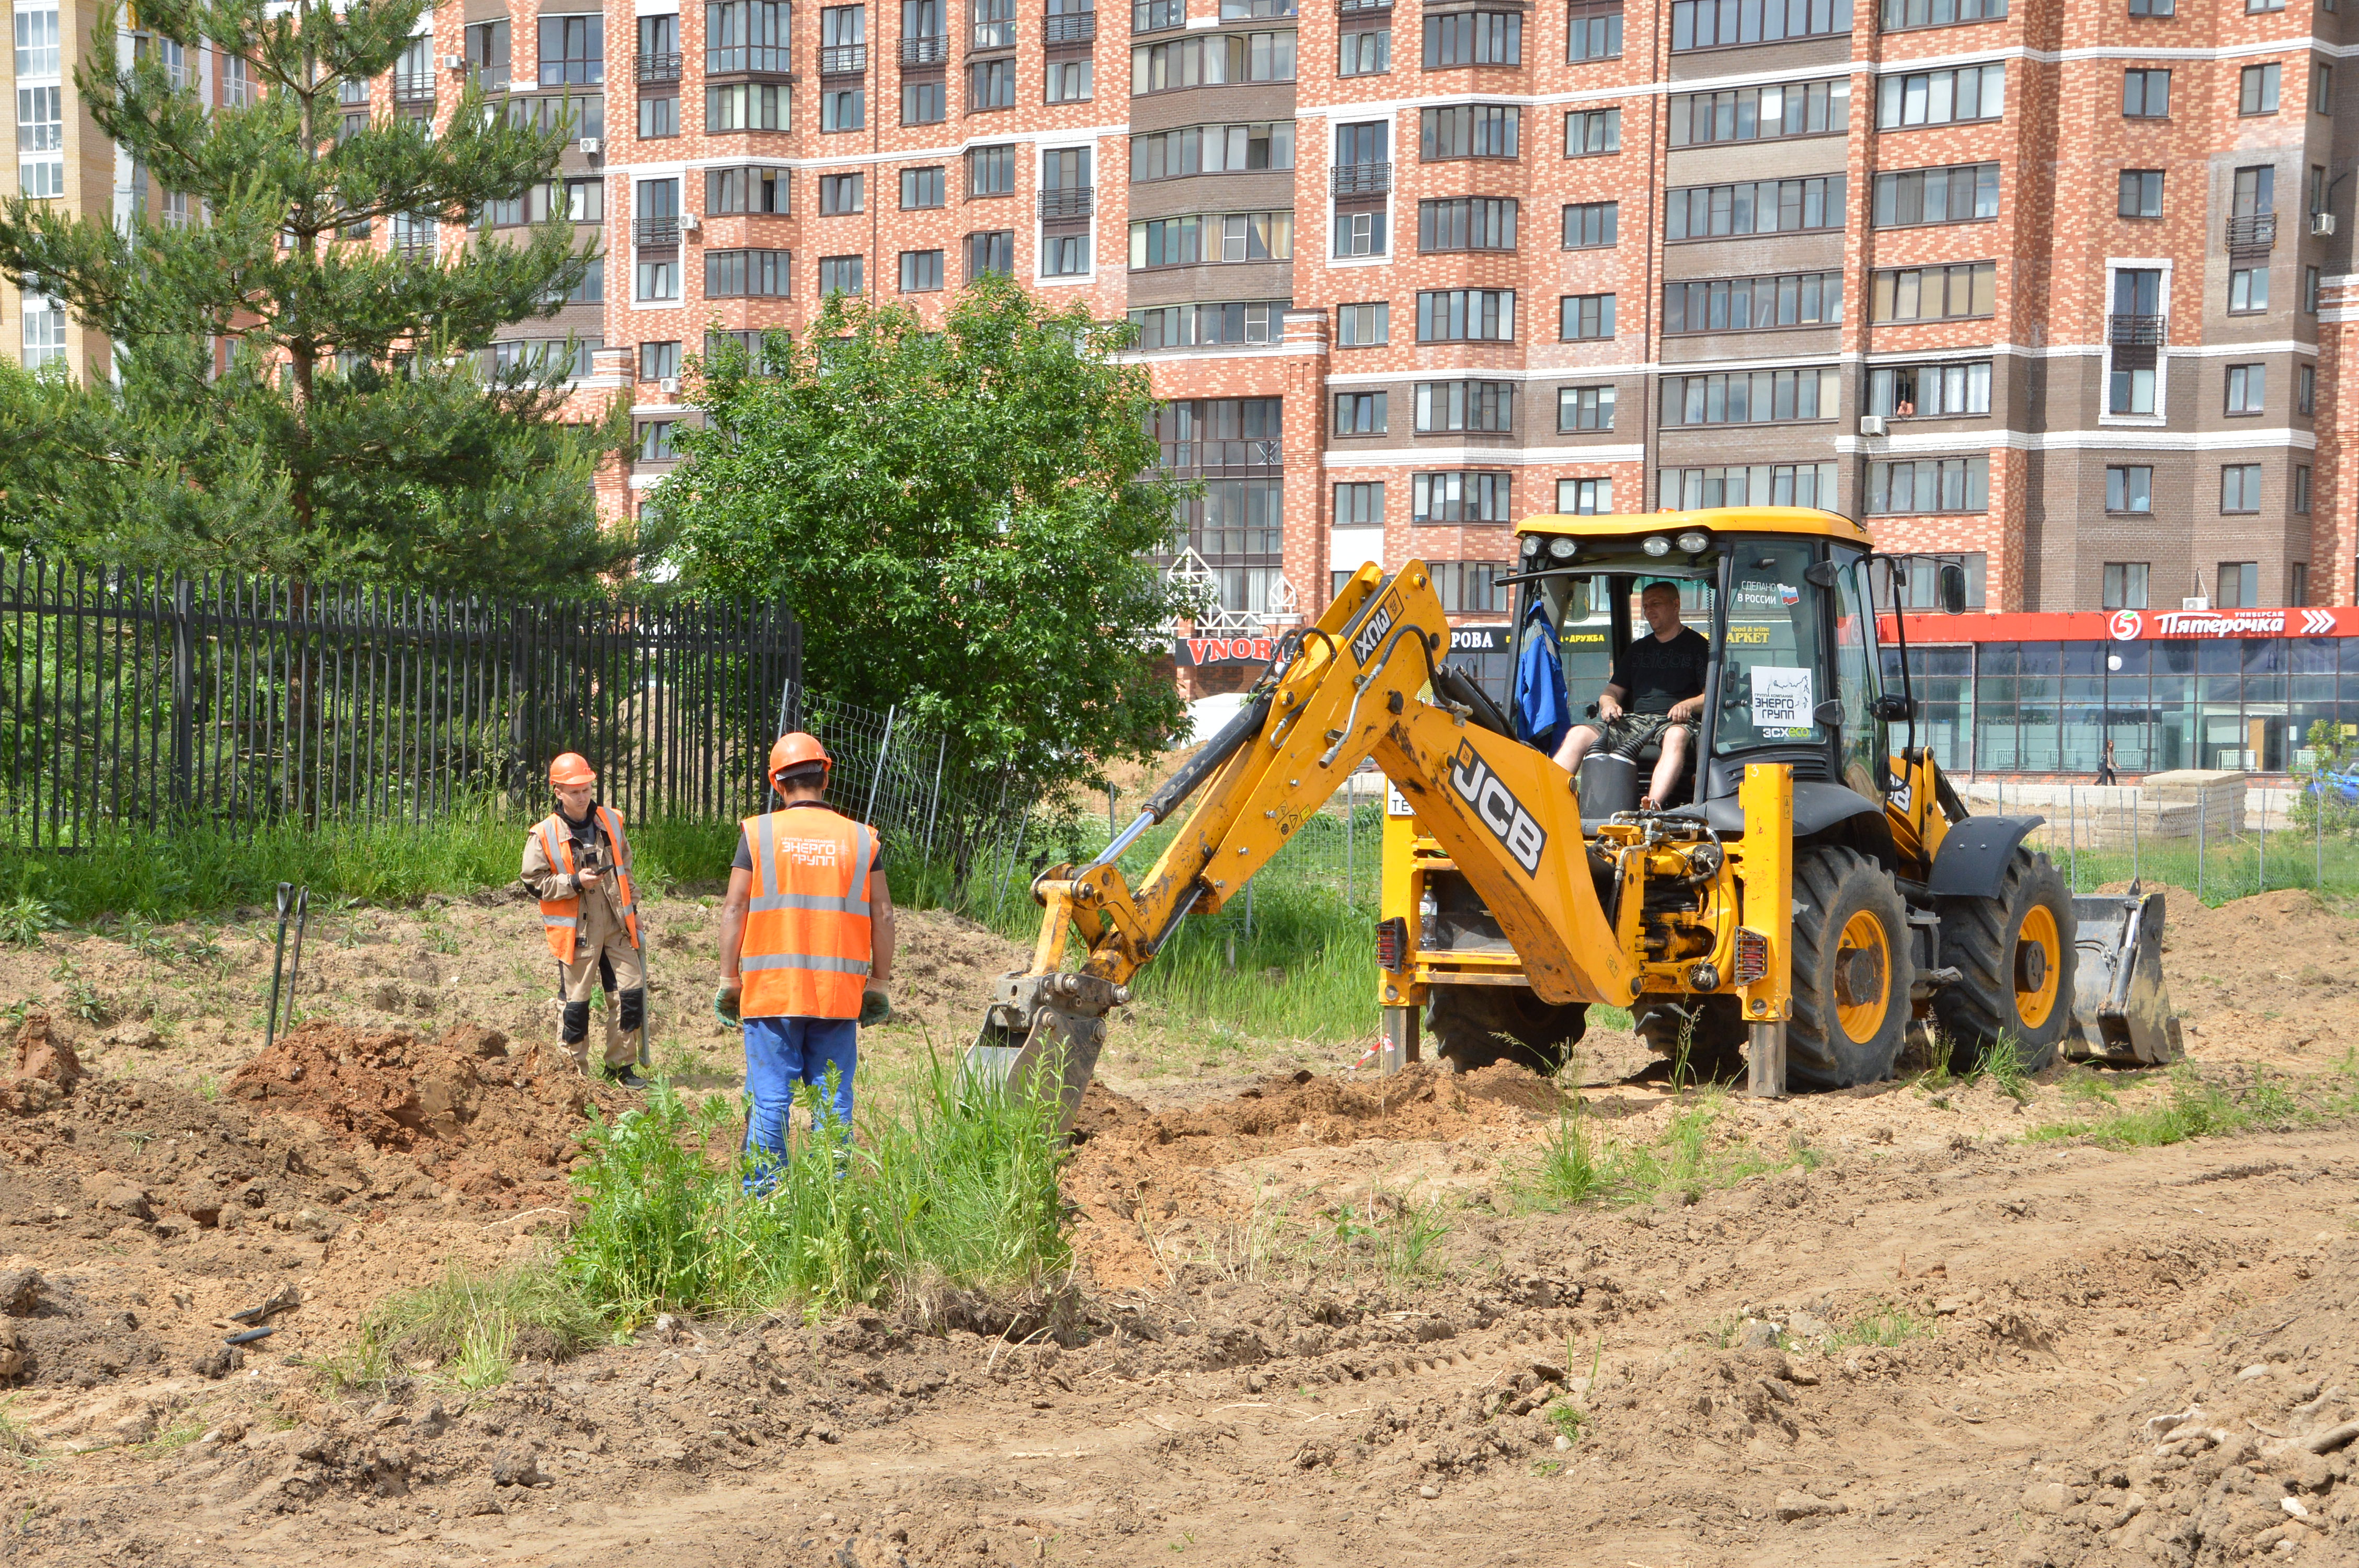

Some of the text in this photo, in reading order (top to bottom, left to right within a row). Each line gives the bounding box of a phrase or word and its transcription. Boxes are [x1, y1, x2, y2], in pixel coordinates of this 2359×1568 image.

[1742, 581, 1776, 592] СДЕЛАНО
[1737, 593, 1776, 604] В РОССИИ
[1356, 608, 1390, 662] 3CX
[1755, 698, 1794, 709] ЭНЕРГО
[1762, 709, 1794, 720] ГРУПП
[1453, 761, 1542, 870] JCB
[782, 841, 835, 855] ЭНЕРГО
[792, 854, 835, 866] ГРУПП
